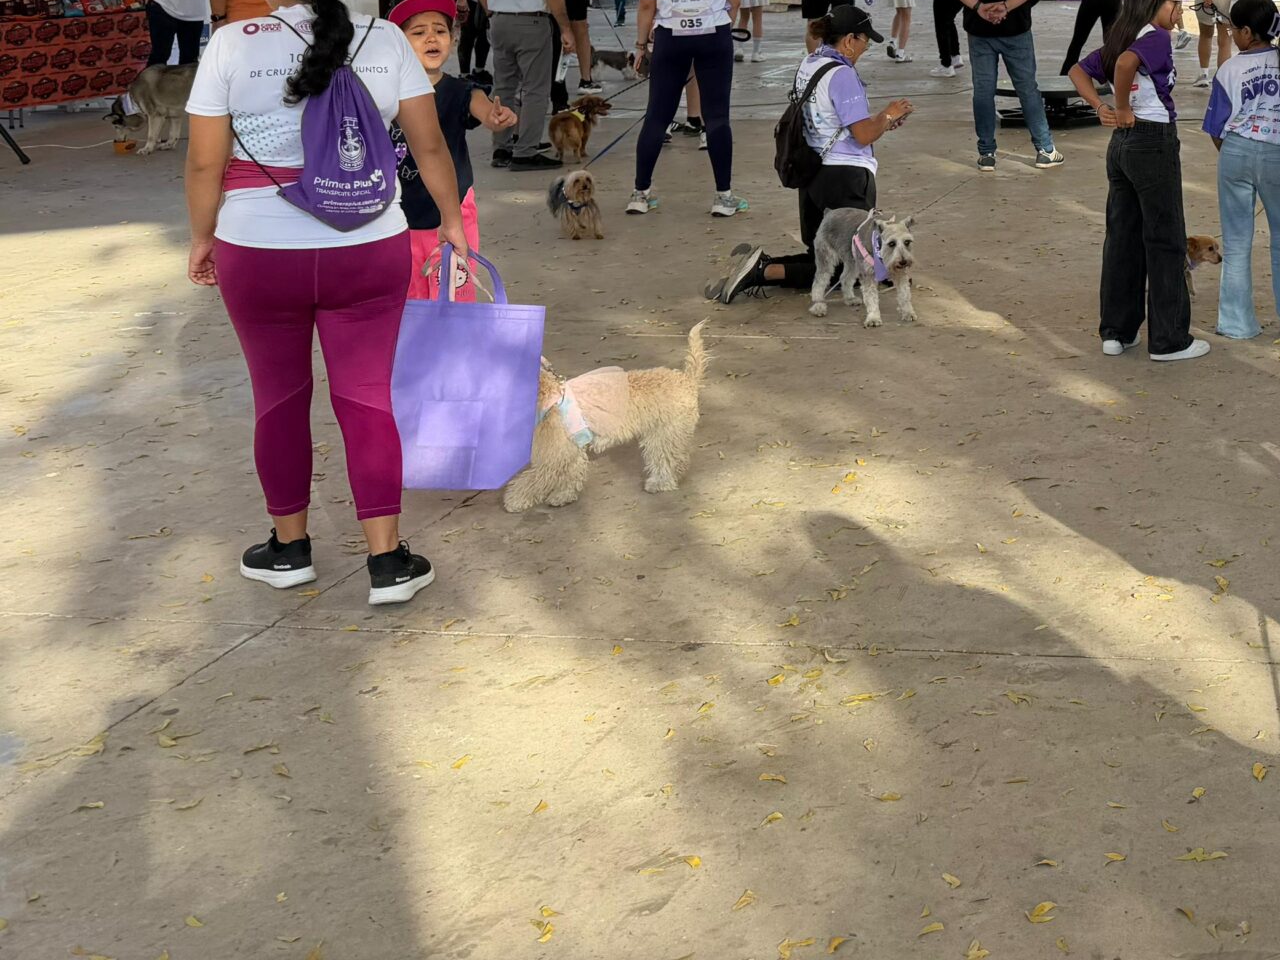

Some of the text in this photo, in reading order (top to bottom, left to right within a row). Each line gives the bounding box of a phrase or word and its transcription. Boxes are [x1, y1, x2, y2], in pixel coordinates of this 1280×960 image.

[680, 18, 703, 29] 035
[250, 70, 263, 78] DE
[266, 69, 300, 77] CRUZA
